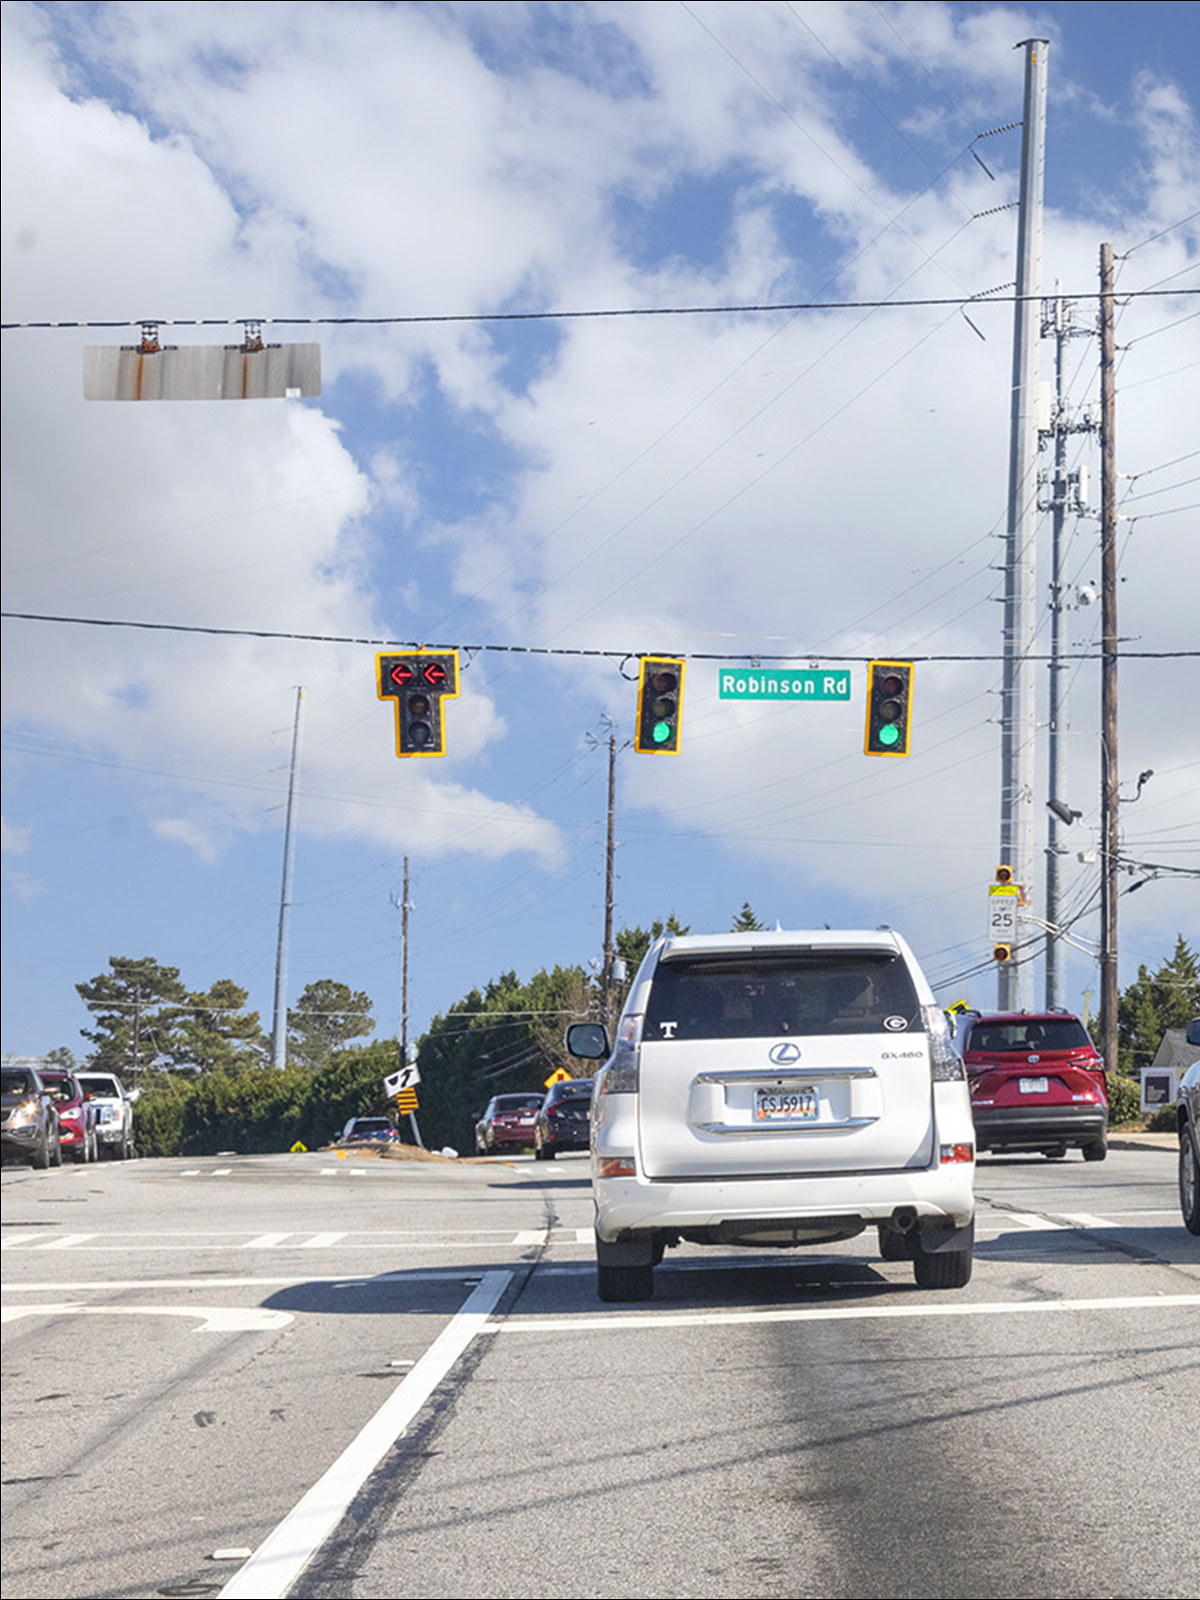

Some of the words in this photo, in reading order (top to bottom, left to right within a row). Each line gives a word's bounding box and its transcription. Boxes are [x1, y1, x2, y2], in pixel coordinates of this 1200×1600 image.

[722, 675, 815, 694] Robinson
[823, 677, 847, 694] Rd
[991, 913, 1013, 927] 25
[660, 1022, 676, 1038] T
[761, 1096, 812, 1113] CSJ5917
